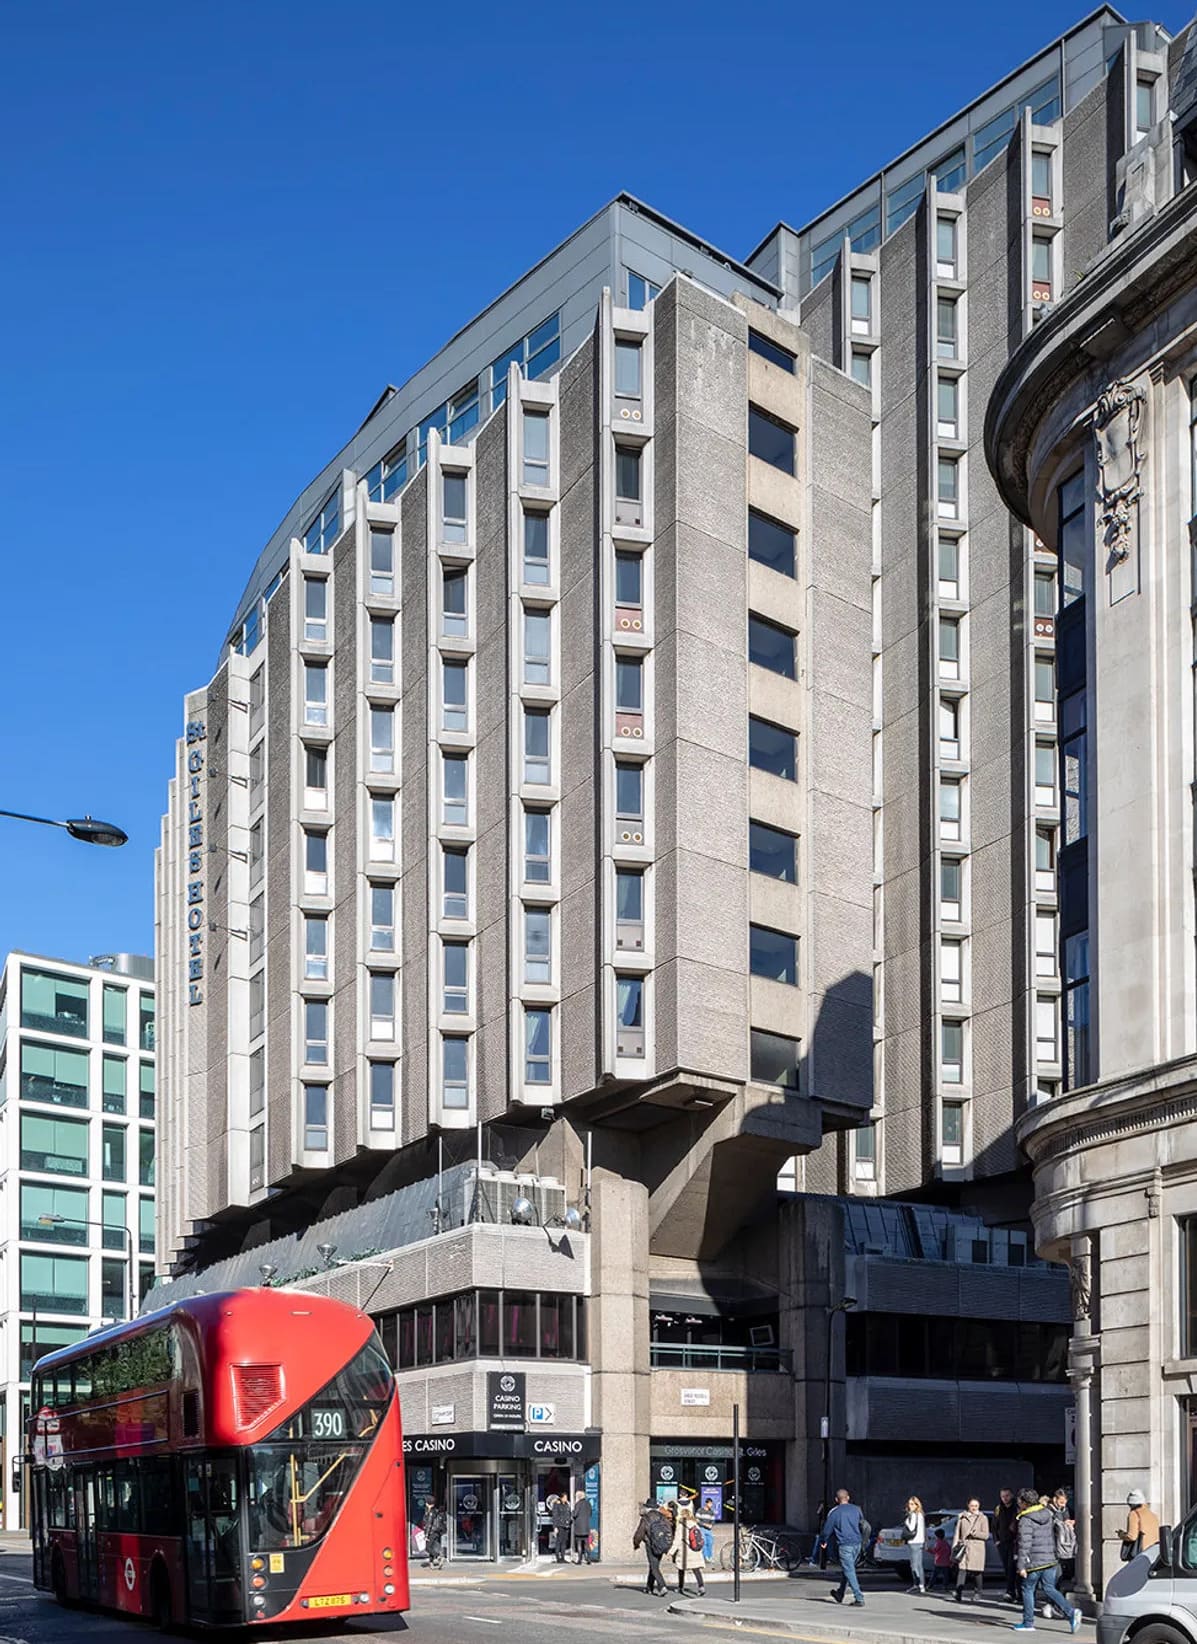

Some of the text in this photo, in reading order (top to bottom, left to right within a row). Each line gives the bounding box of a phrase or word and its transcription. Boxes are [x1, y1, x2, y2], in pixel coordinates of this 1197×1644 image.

[187, 750, 204, 873] GILES
[187, 881, 204, 1006] HOTEL
[533, 1408, 542, 1419] P
[313, 1412, 343, 1437] 390
[414, 1438, 456, 1451] CASINO
[534, 1440, 583, 1453] CASINO
